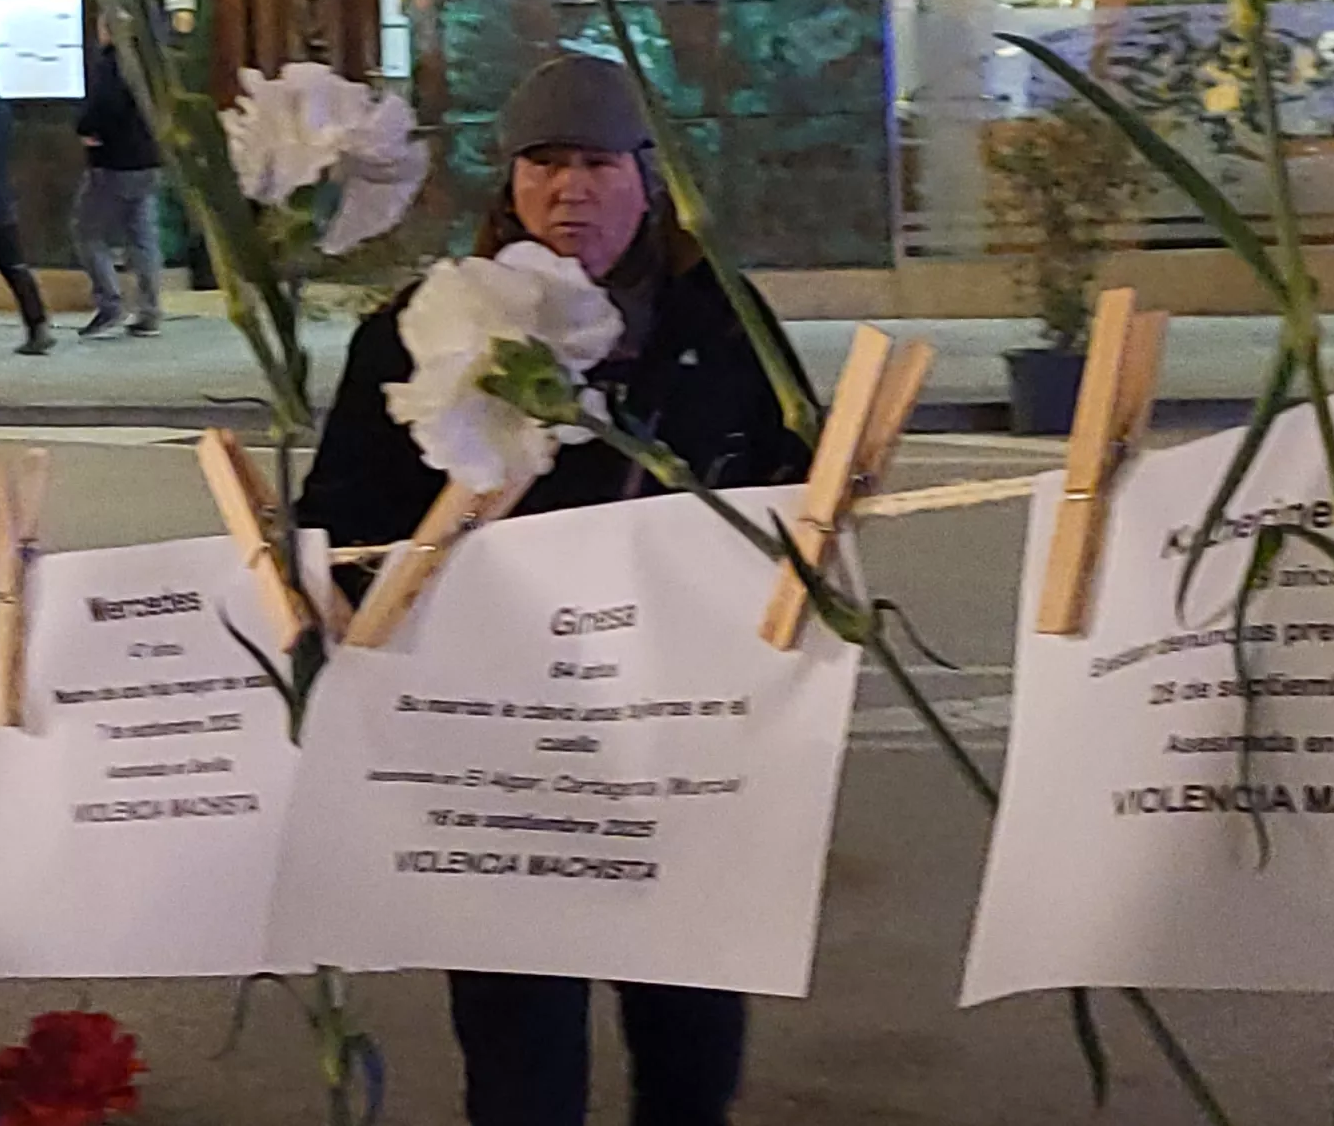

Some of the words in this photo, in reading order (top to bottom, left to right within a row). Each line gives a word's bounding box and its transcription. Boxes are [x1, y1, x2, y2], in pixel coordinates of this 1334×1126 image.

[72, 799, 167, 824] VIOLENCIA
[167, 792, 261, 819] MACHISTA
[1111, 783, 1294, 817] VIOLENCIA
[394, 849, 522, 877] VIOLENCIA
[525, 855, 659, 882] MACHISTA
